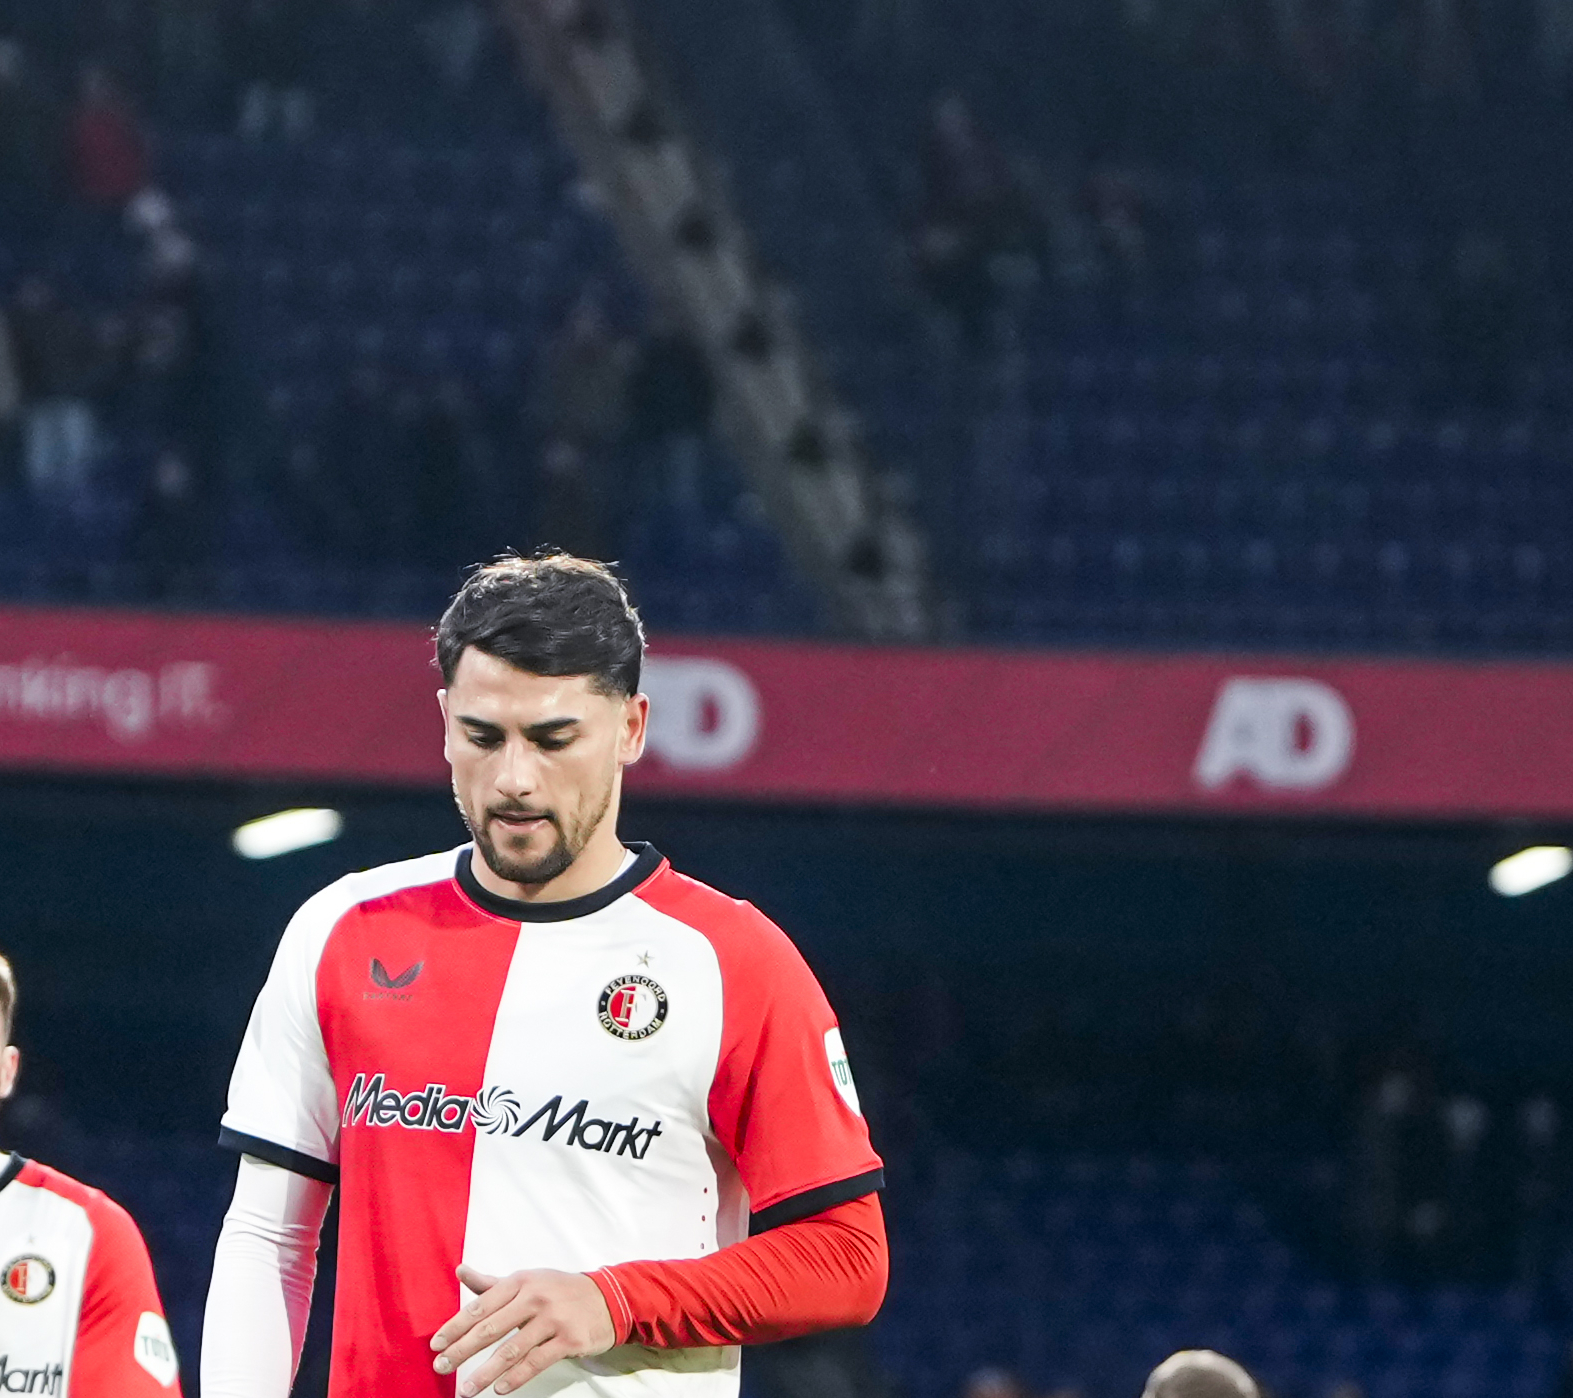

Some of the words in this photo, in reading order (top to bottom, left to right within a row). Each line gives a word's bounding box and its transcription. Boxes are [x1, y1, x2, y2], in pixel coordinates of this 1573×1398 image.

[1192, 675, 1355, 790] AD
[604, 975, 667, 1003] FEYENOORD
[598, 1010, 663, 1040] ROTTERDAM
[342, 1073, 474, 1133] Media
[511, 1095, 663, 1160] Markt
